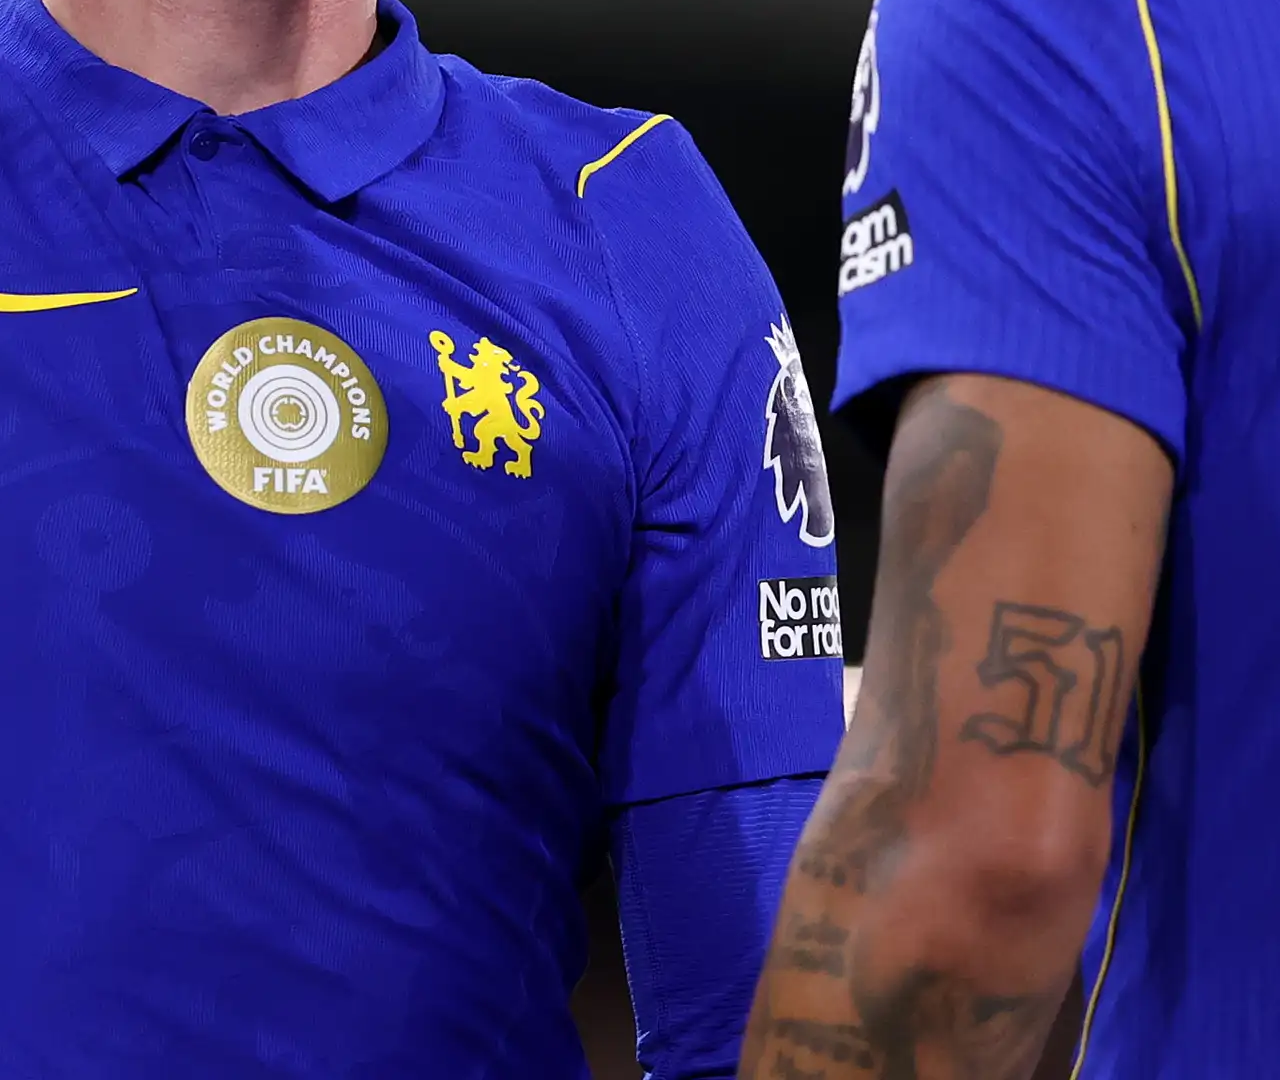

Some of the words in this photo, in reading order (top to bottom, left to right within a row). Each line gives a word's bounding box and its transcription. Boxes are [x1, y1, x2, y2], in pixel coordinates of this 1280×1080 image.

[206, 346, 254, 435] WORLD
[258, 334, 371, 441] CHAMPIONS
[253, 467, 329, 494] FIFA
[760, 581, 807, 622] No
[958, 597, 1124, 789] 51
